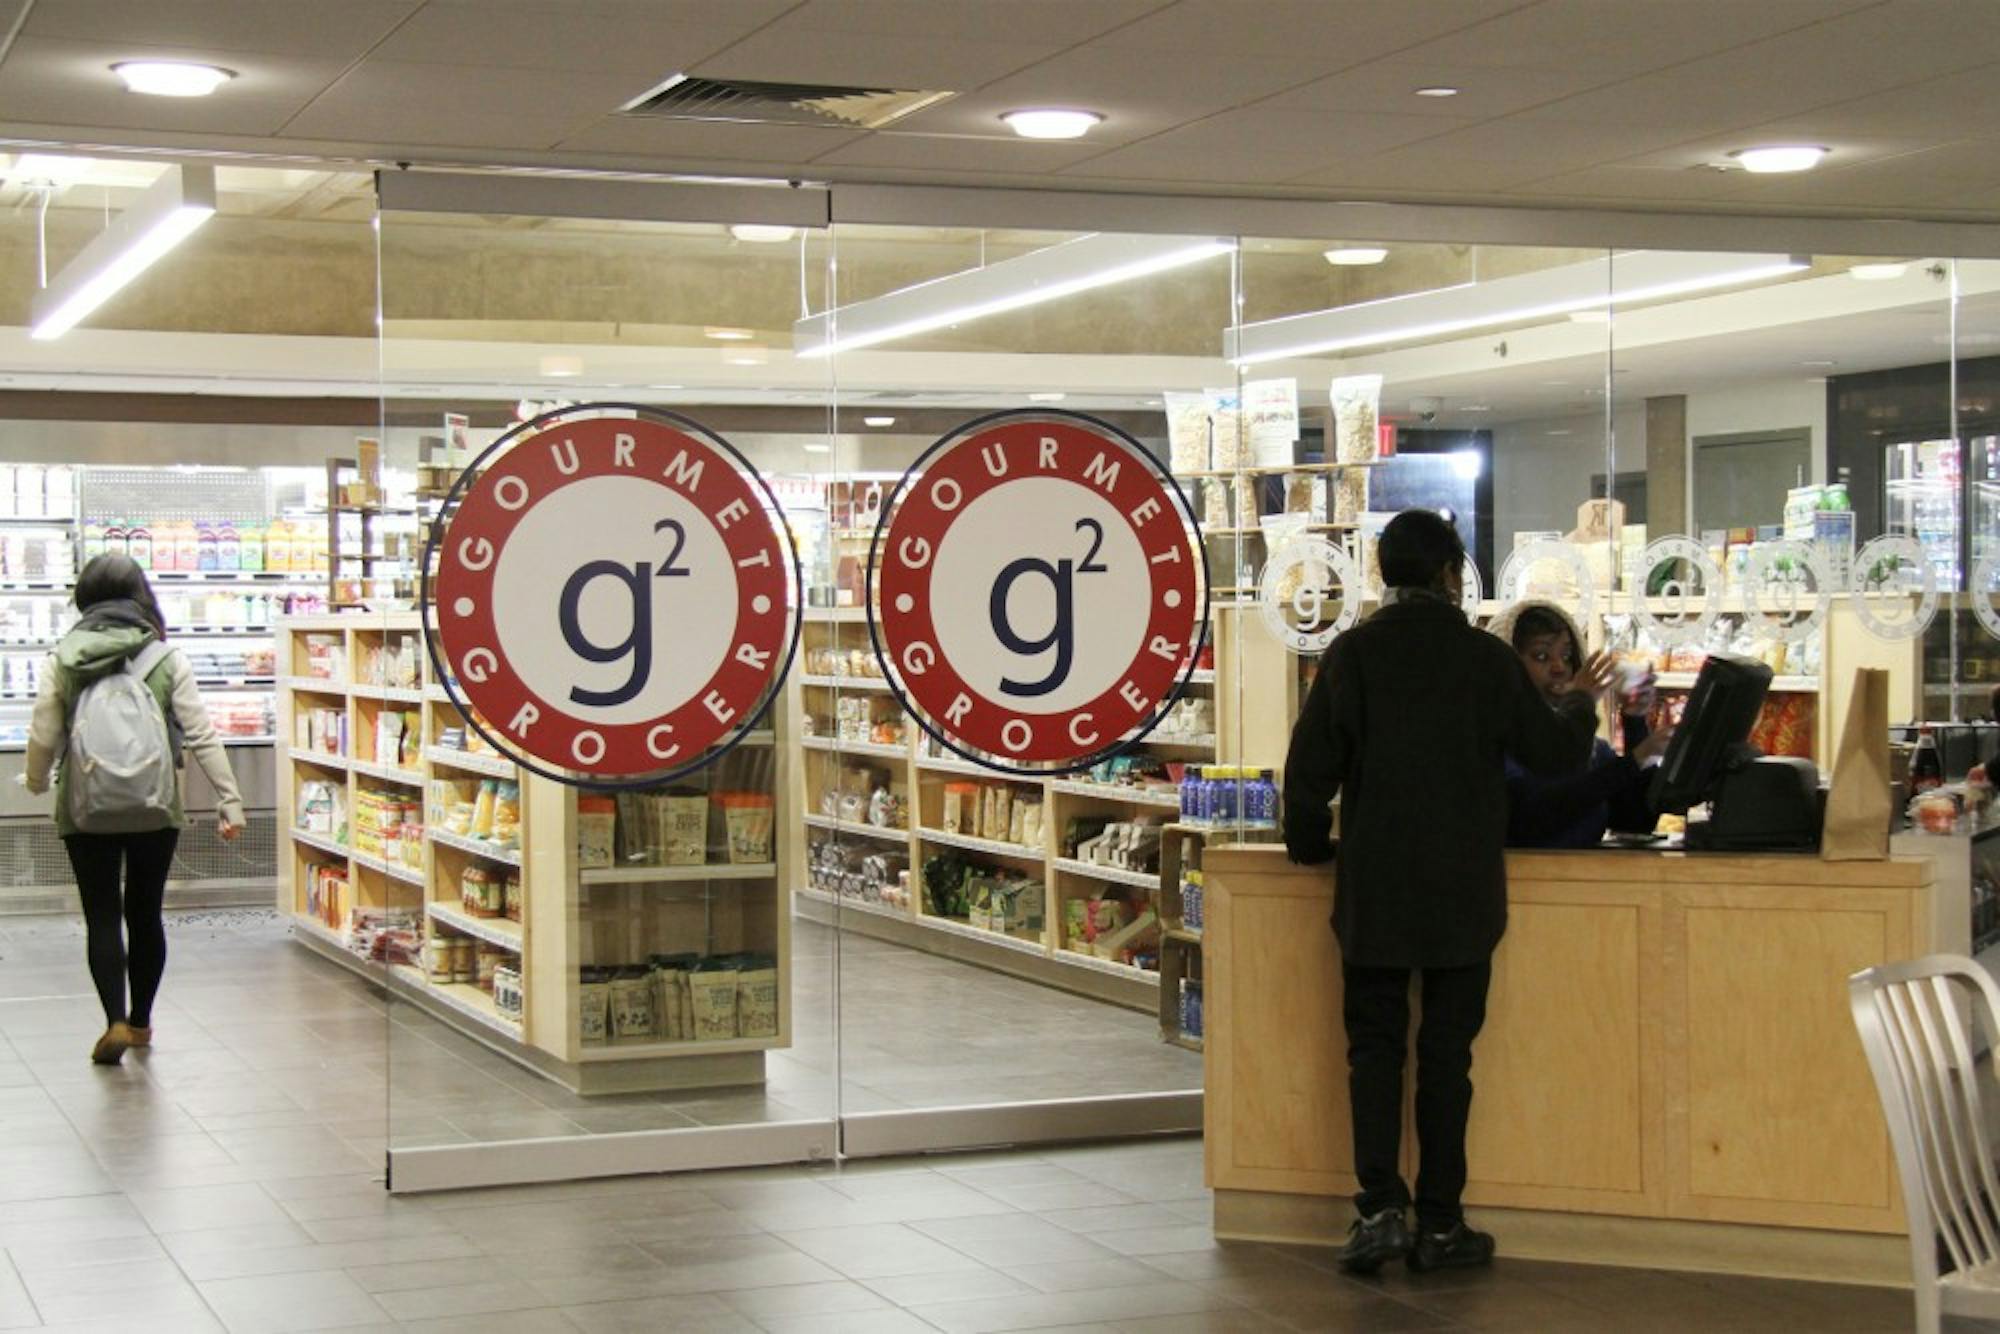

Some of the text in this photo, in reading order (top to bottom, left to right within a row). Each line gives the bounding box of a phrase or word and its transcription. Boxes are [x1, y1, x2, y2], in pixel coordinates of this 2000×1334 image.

[459, 433, 771, 572] GOURMET
[899, 437, 1180, 569] GOURMET
[462, 642, 771, 765] GROCER
[902, 635, 1181, 752] GROCER
